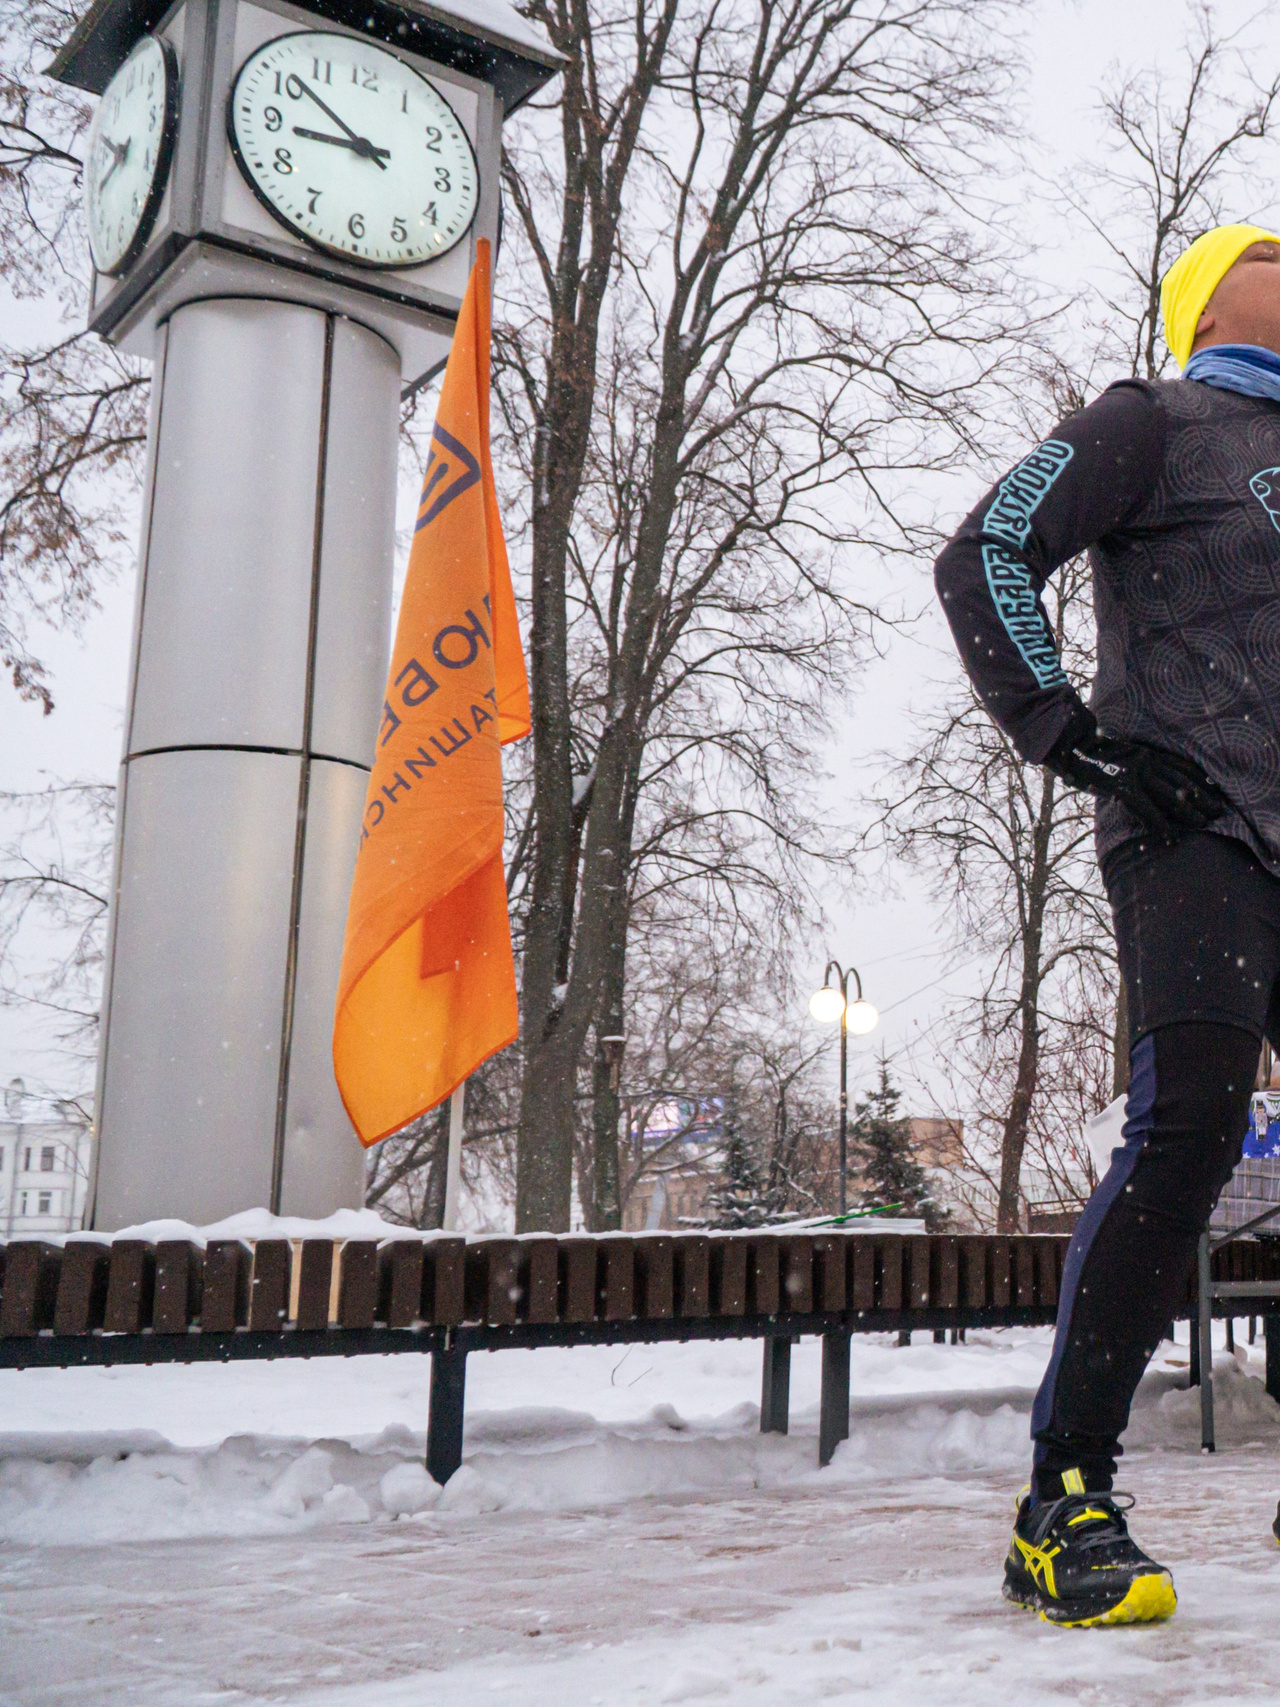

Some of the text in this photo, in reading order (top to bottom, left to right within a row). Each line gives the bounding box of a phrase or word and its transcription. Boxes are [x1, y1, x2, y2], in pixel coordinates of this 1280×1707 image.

[312, 57, 332, 86] 11
[351, 64, 379, 93] 12
[274, 70, 304, 101] 10
[401, 90, 409, 115] 1
[263, 105, 283, 132] 9
[426, 126, 443, 154] 2
[273, 147, 293, 175] 8
[434, 166, 451, 193] 3
[306, 187, 323, 216] 7
[422, 201, 440, 226] 4
[348, 212, 365, 239] 6
[390, 216, 408, 243] 5
